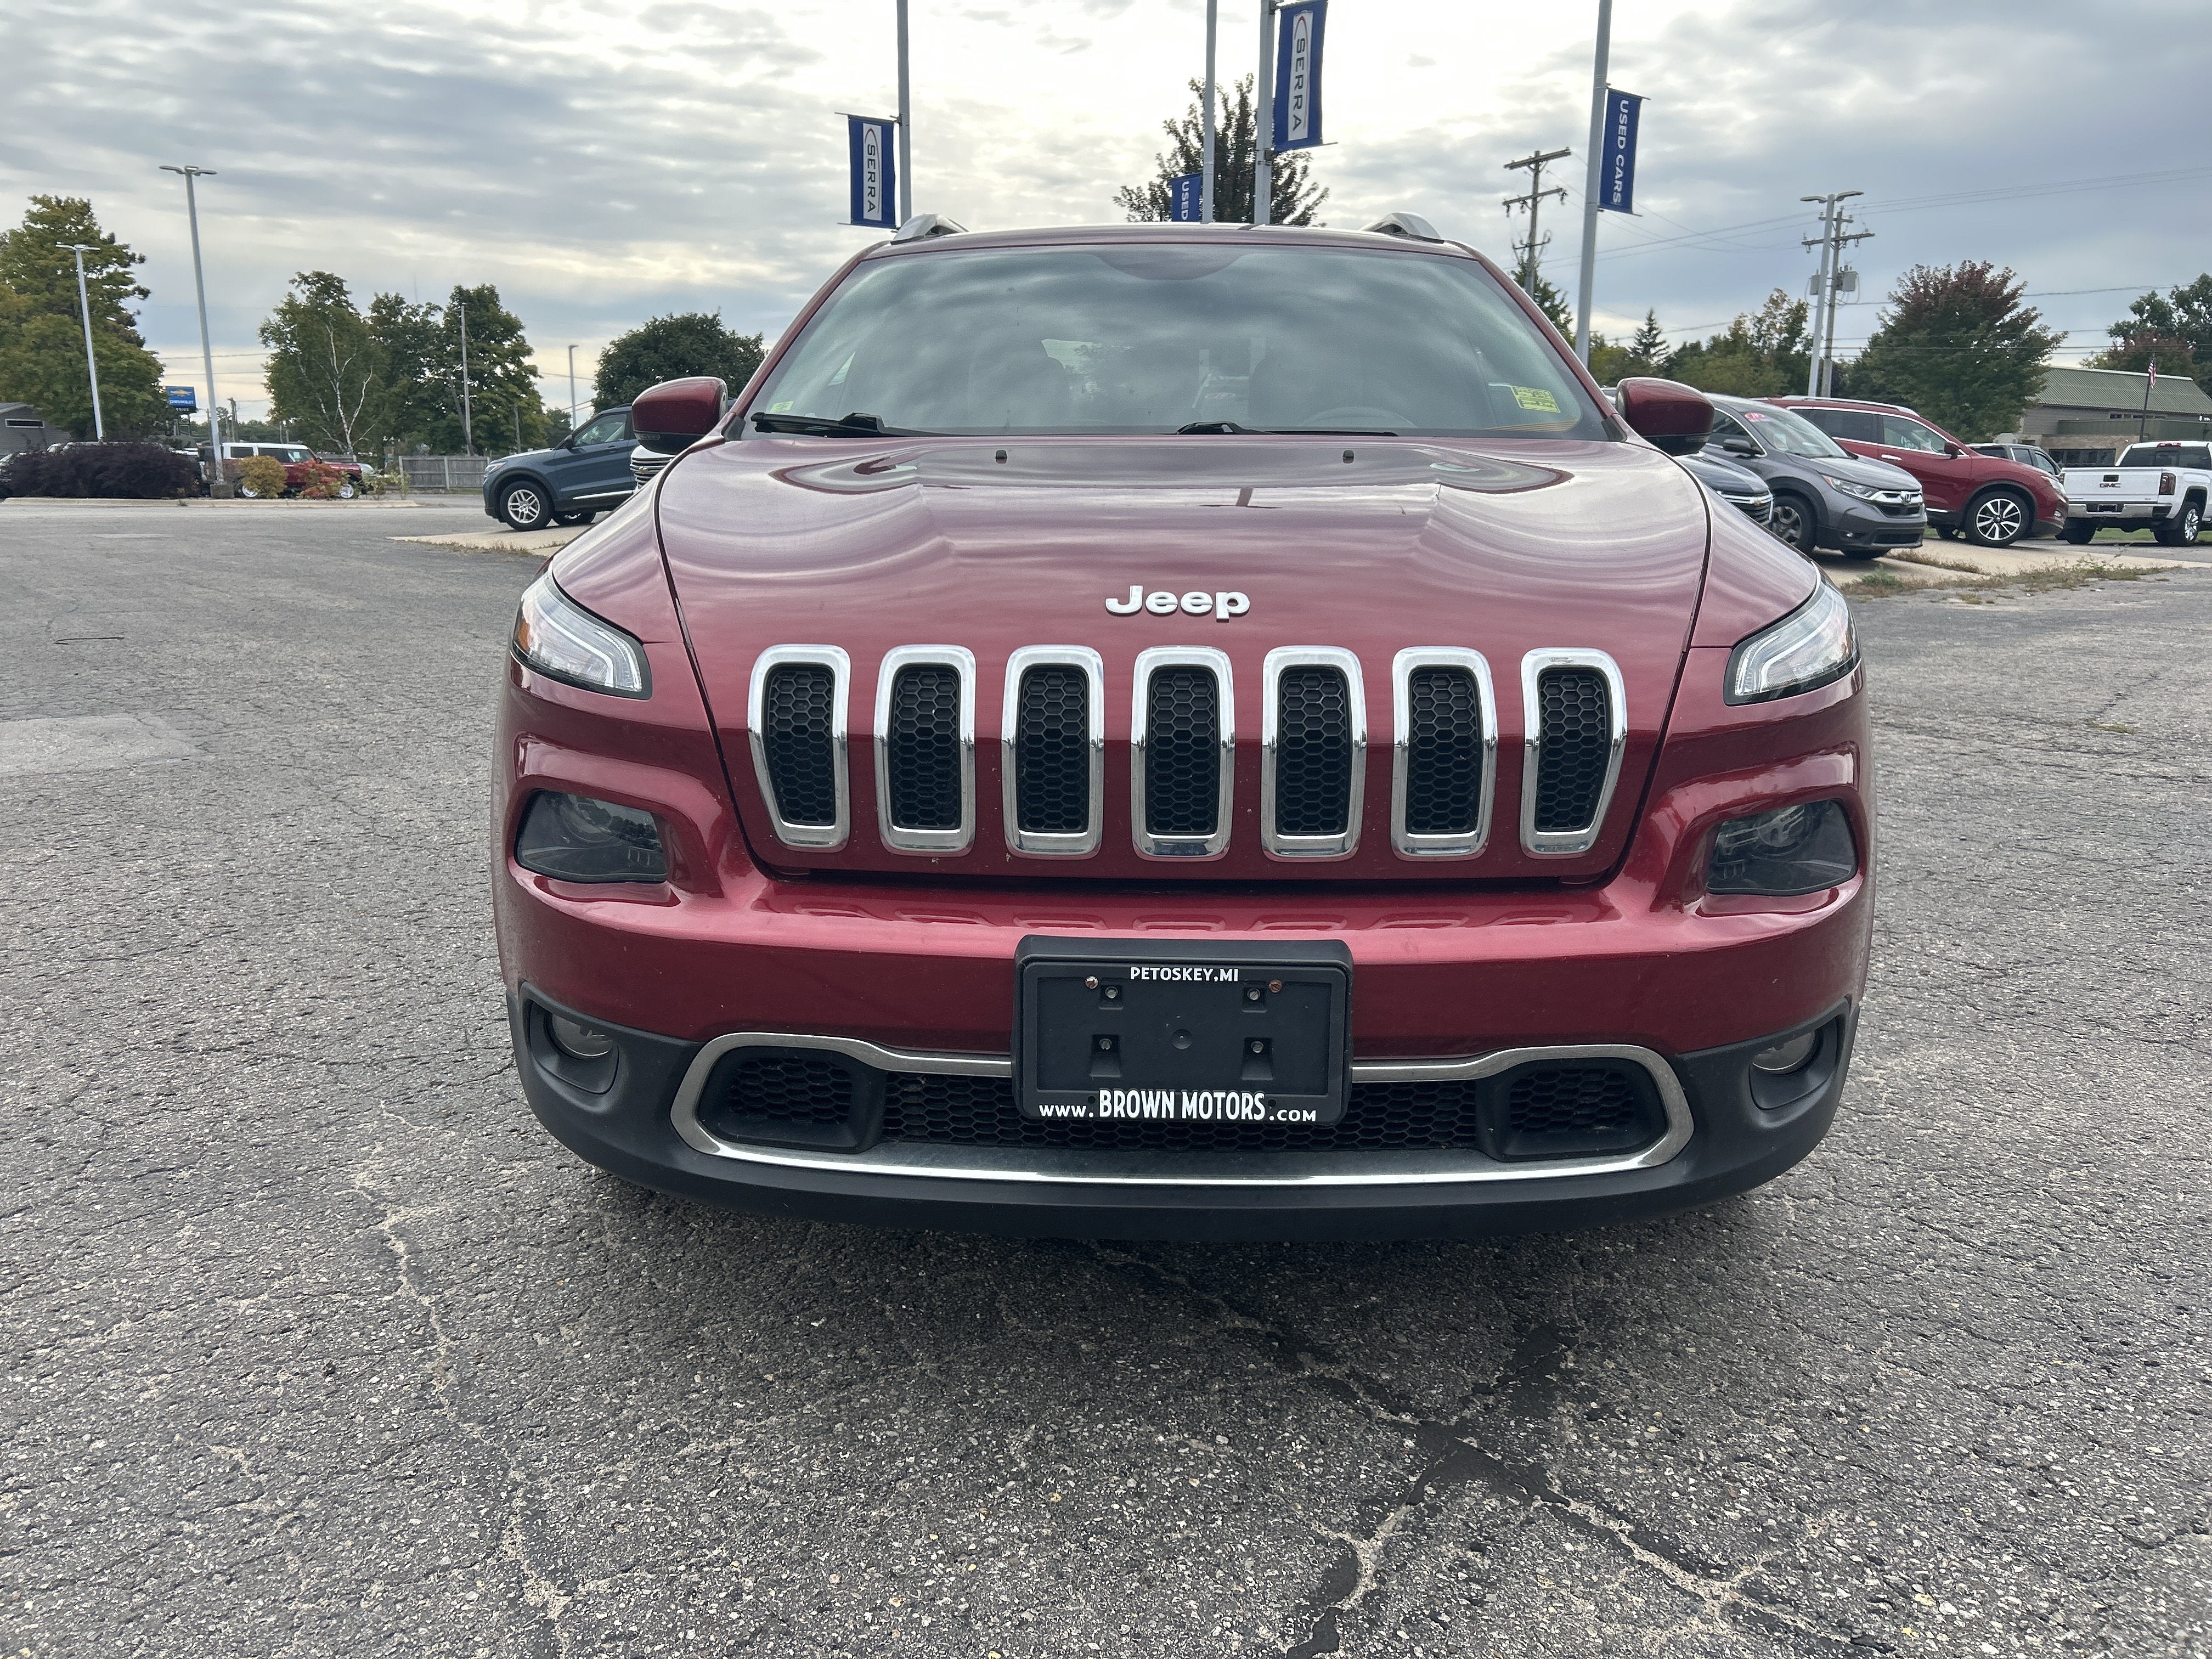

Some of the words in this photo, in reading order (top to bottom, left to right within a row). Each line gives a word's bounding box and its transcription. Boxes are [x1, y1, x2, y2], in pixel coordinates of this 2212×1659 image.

[1293, 38, 1306, 132] SERRA
[1617, 99, 1629, 150] USED
[867, 144, 876, 212] SERRA
[1181, 181, 1189, 221] USED
[1612, 154, 1624, 203] CARS
[1105, 585, 1250, 623] Jeep
[1099, 1090, 1175, 1119] BROWN
